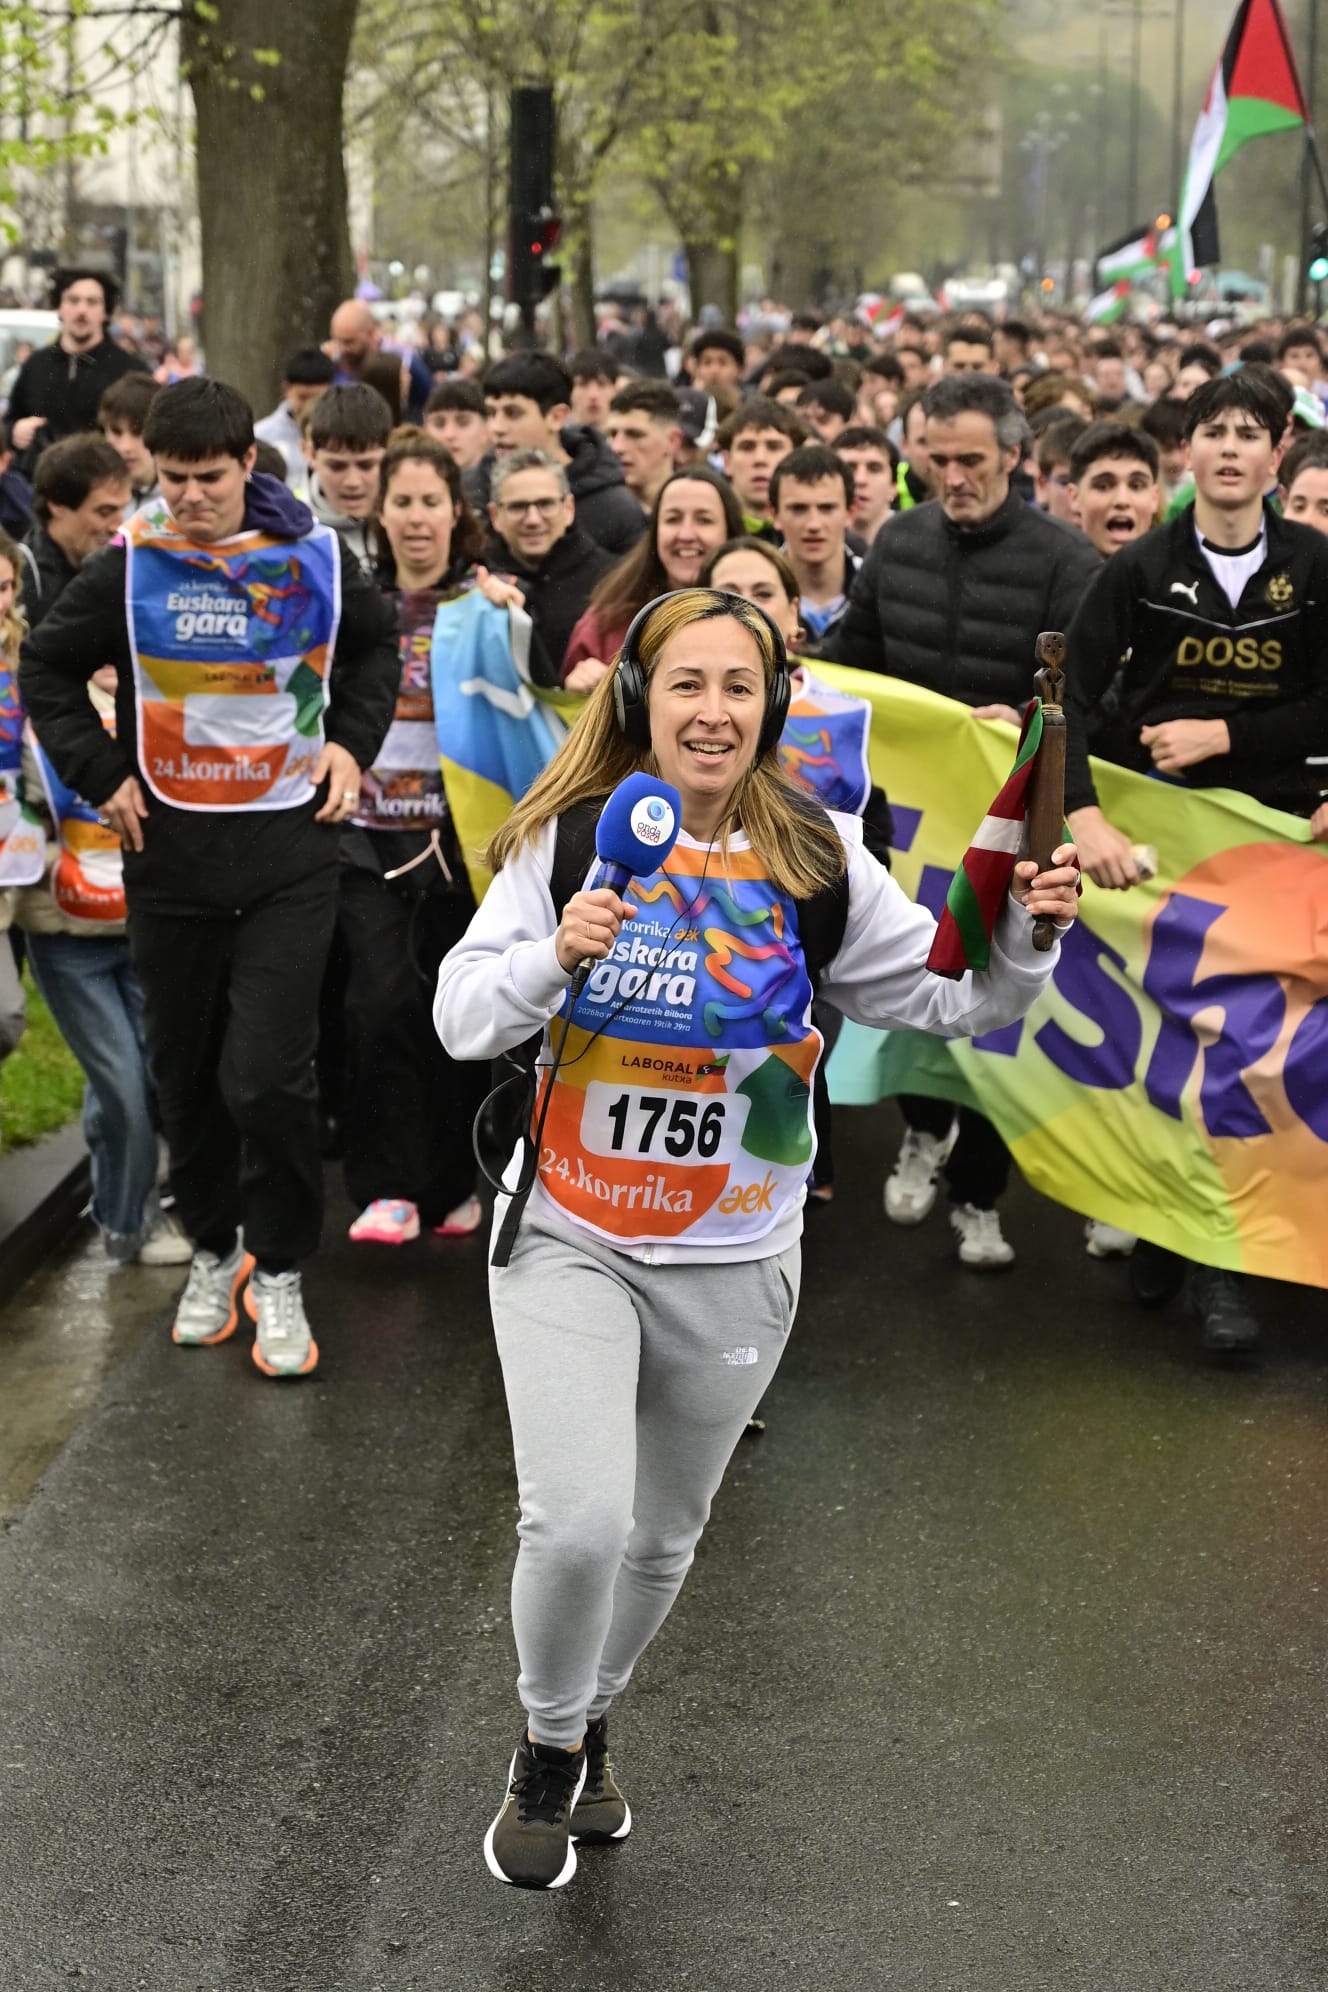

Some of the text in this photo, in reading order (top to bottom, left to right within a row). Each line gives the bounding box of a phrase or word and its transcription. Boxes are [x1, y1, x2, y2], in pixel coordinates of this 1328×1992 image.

[167, 592, 247, 613] Euskara
[175, 612, 248, 641] gara
[1176, 636, 1282, 670] DOSS
[153, 754, 271, 781] 24.korrika
[636, 828, 661, 843] vasca
[637, 822, 661, 836] onda
[586, 964, 697, 1007] gara
[577, 1006, 605, 1018] 2026ko
[673, 1022, 691, 1032] 29ra
[664, 1009, 692, 1020] Bilbora
[621, 1055, 693, 1075] LABORAL
[662, 1072, 692, 1084] kutxa
[608, 1094, 726, 1158] 1756
[539, 1148, 779, 1214] 24.korrika aek
